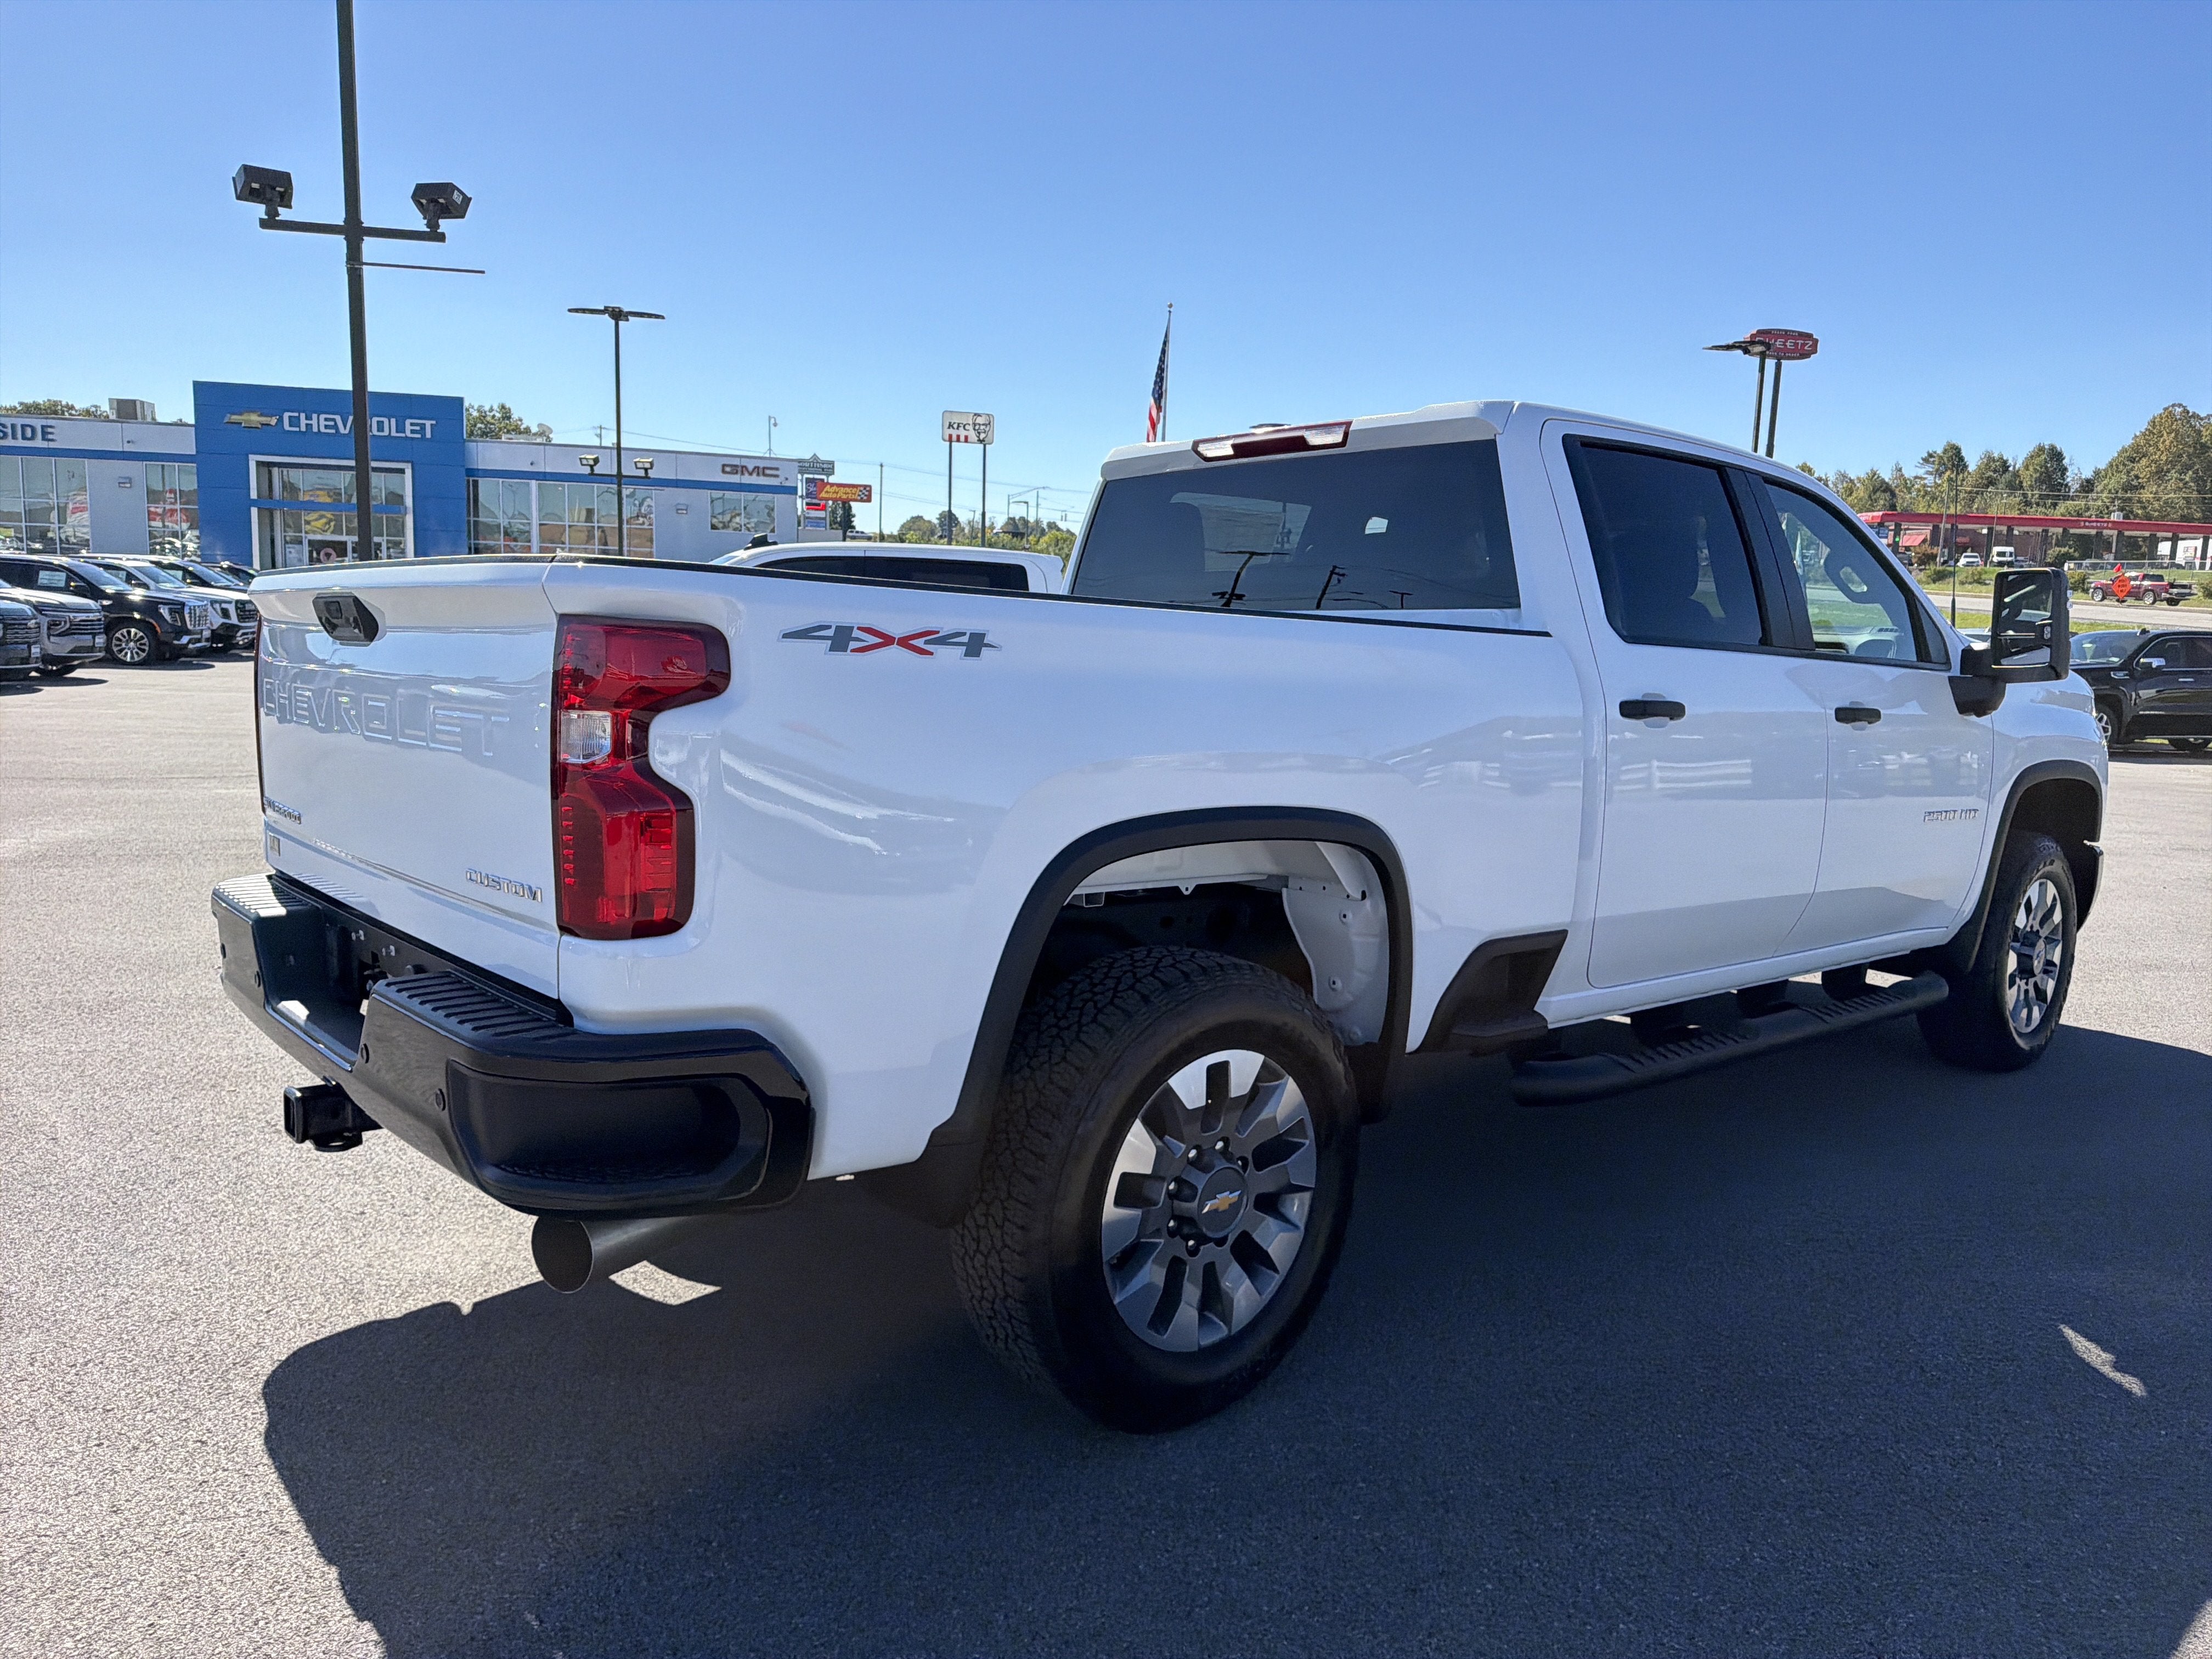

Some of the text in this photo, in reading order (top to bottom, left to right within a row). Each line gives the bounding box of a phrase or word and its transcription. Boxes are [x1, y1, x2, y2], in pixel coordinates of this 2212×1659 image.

[283, 411, 436, 438] CHEVOLET
[947, 421, 970, 431] KFC
[721, 464, 780, 478] GMC
[823, 484, 856, 493] Advance
[263, 678, 509, 756] CHEVROLET
[466, 868, 543, 902] CUSTOM
